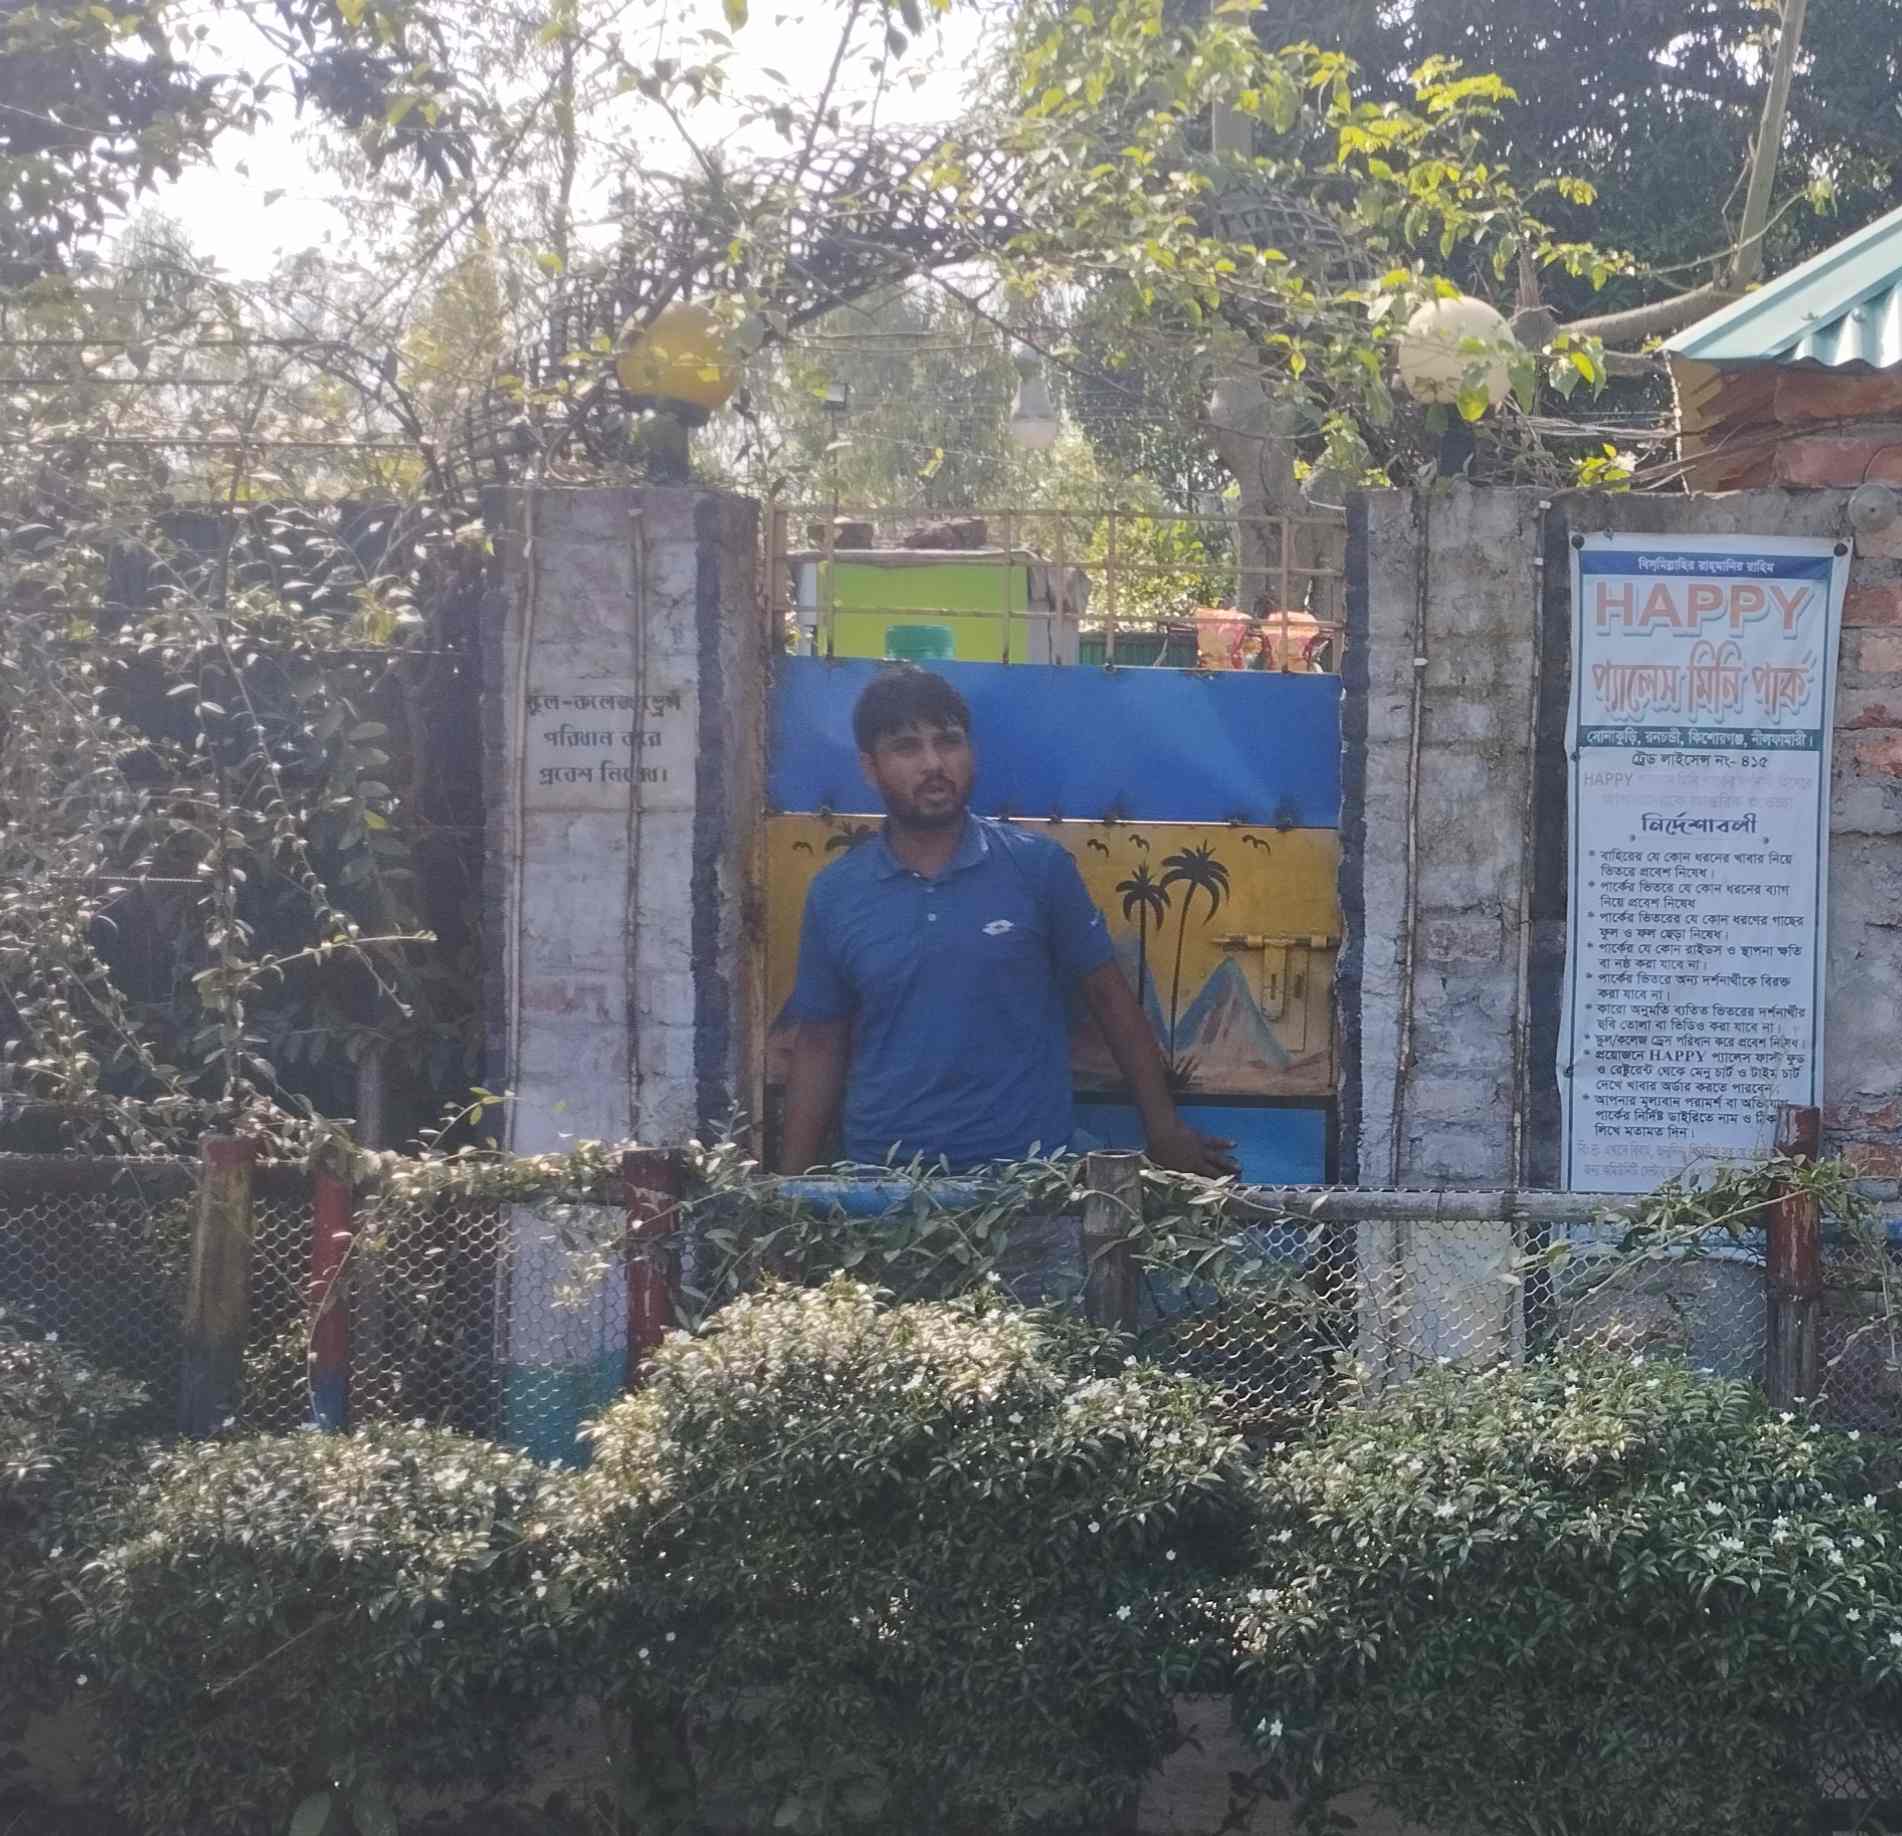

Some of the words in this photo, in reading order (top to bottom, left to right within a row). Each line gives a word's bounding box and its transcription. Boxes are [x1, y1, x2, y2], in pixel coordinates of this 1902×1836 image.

[1596, 582, 1814, 637] HAPPY
[1592, 655, 1681, 720] প্যালেস
[1688, 640, 1744, 723] মিনি
[1751, 650, 1817, 724] পার্ক
[1584, 772, 1632, 786] HAPPY
[1642, 812, 1757, 835] নির্দেশাবলী
[1664, 852, 1690, 863] কোন
[1696, 884, 1721, 894] কোন
[1702, 915, 1729, 925] কোন
[1656, 945, 1682, 955] কোন
[1650, 1051, 1705, 1062] HAPPY
